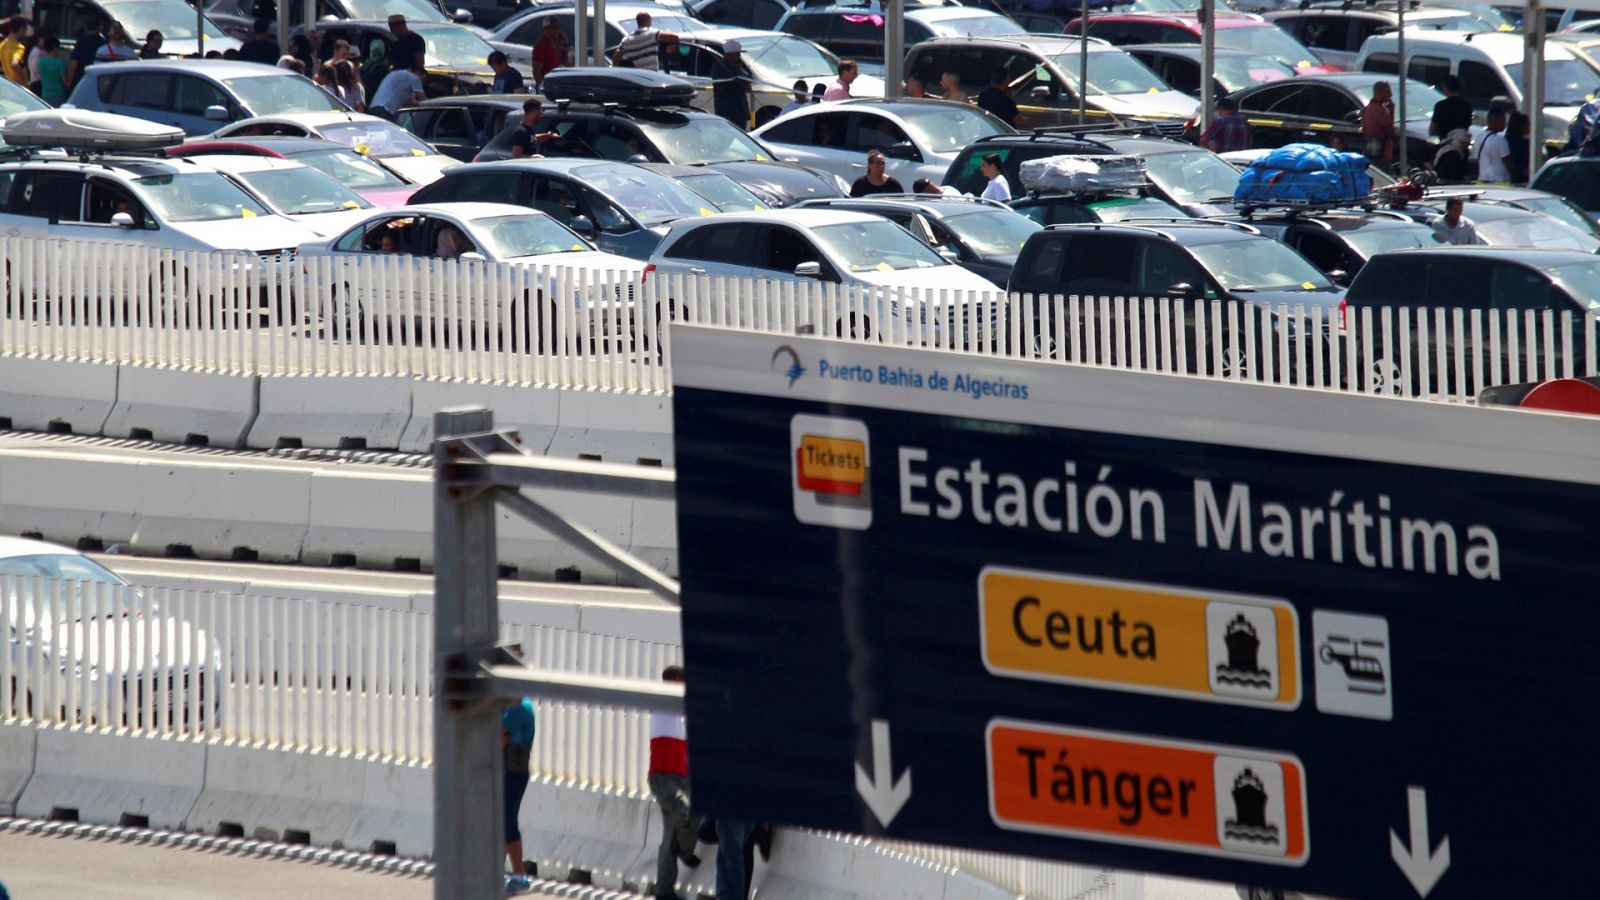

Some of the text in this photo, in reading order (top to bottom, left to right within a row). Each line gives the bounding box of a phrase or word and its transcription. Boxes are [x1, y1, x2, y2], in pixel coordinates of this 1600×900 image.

[819, 360, 873, 383] Puerto
[928, 371, 949, 391] de
[953, 374, 1029, 399] Algeciras
[806, 444, 860, 471] Tickets
[898, 446, 1501, 581] Estación Marítima
[1012, 595, 1157, 661] Ceuta
[1016, 745, 1196, 827] Tánger
